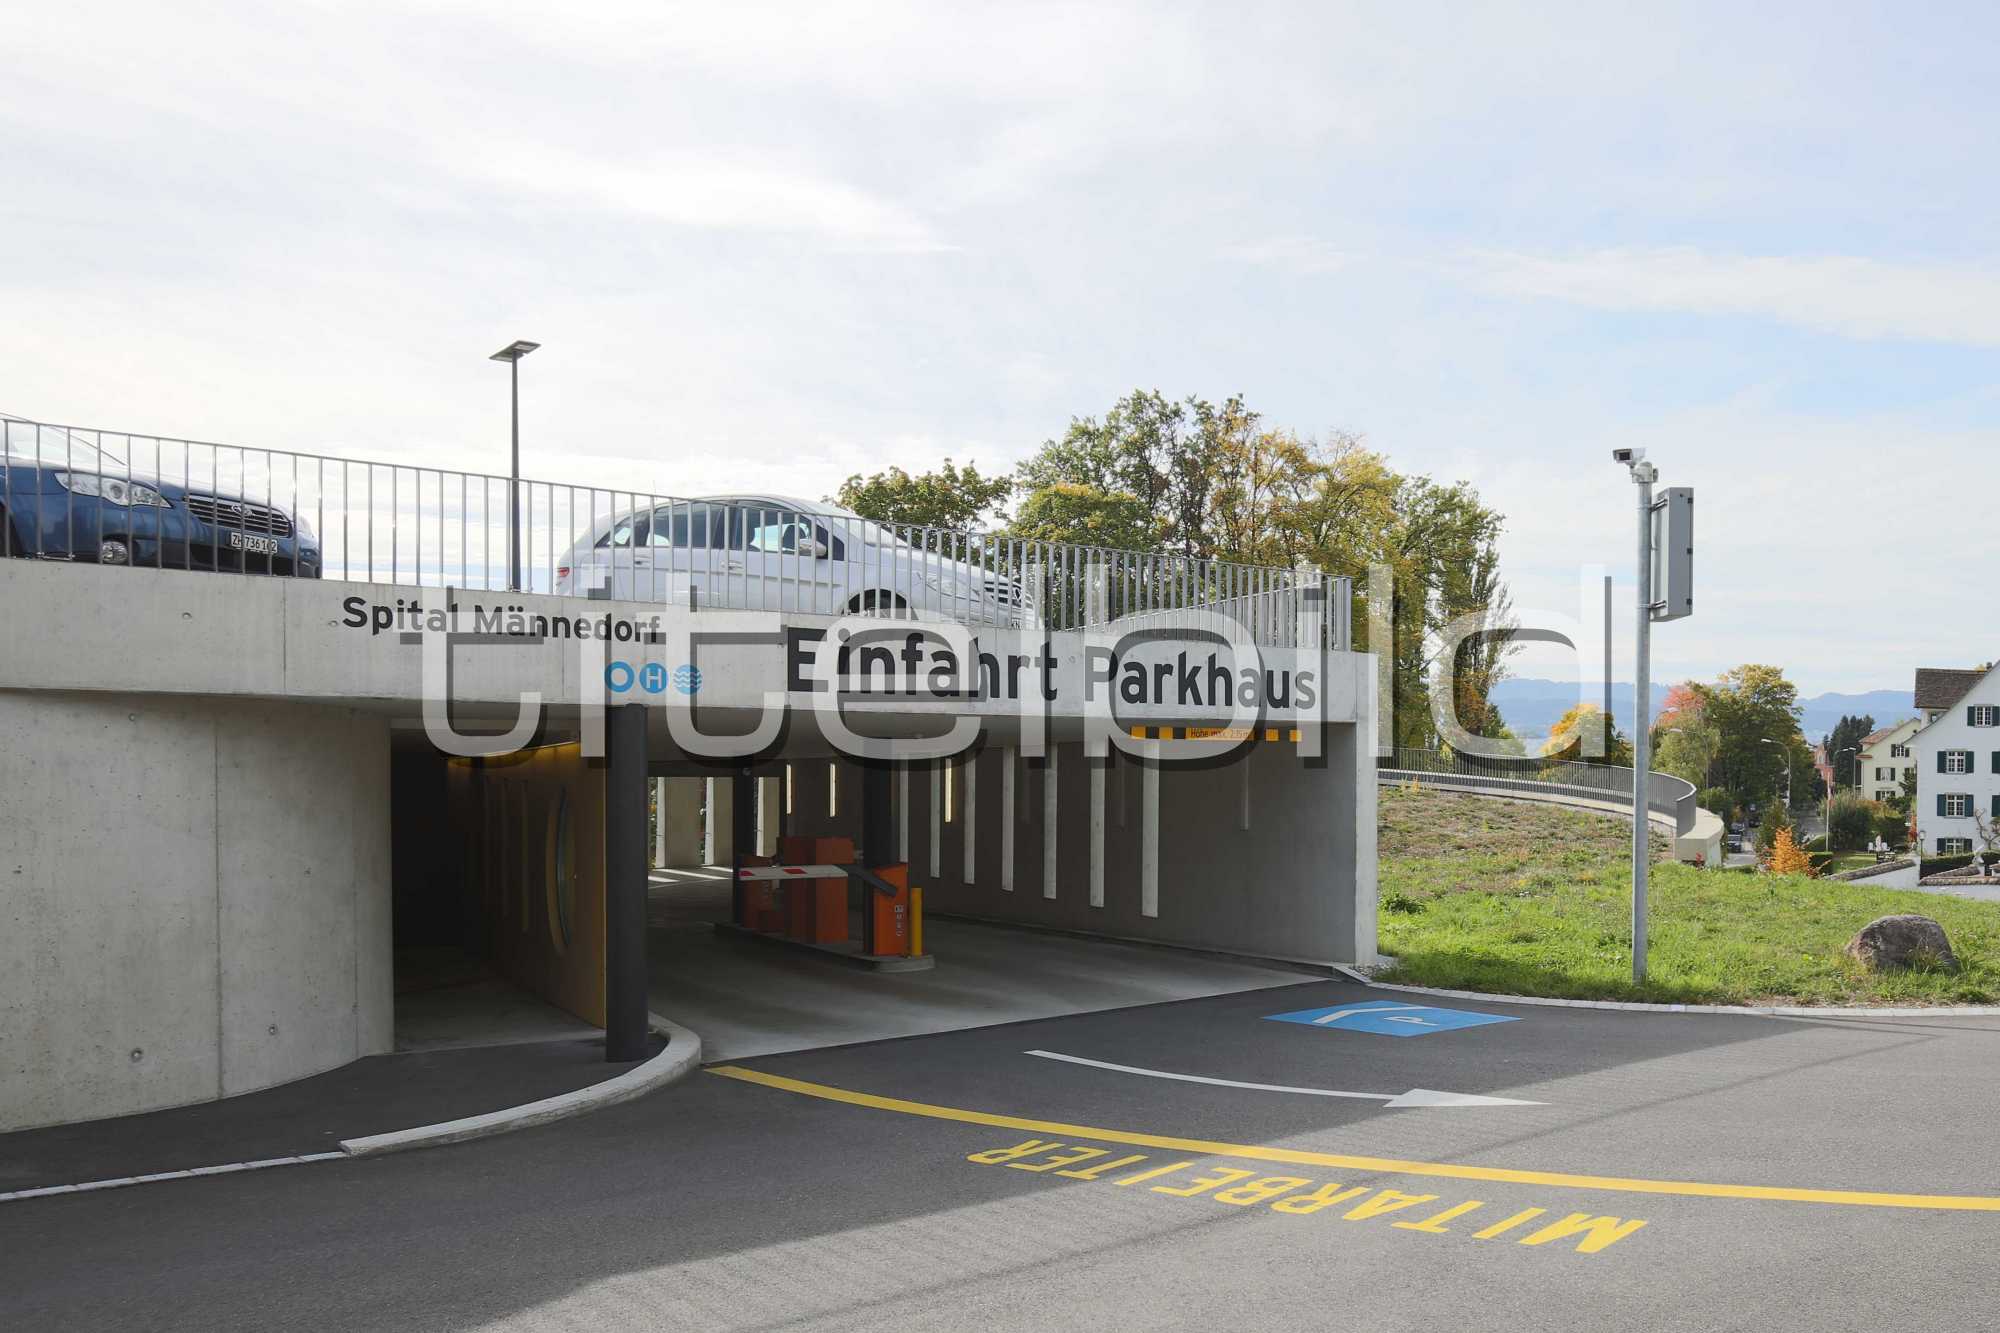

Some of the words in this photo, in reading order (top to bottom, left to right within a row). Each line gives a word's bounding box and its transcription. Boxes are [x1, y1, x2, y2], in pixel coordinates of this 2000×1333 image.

[342, 596, 458, 636] Spital
[473, 604, 661, 643] Männedorf
[787, 626, 1058, 701] Einfahrt
[1084, 644, 1316, 710] Parkhaus
[967, 1140, 1647, 1253] MITARBEITER
